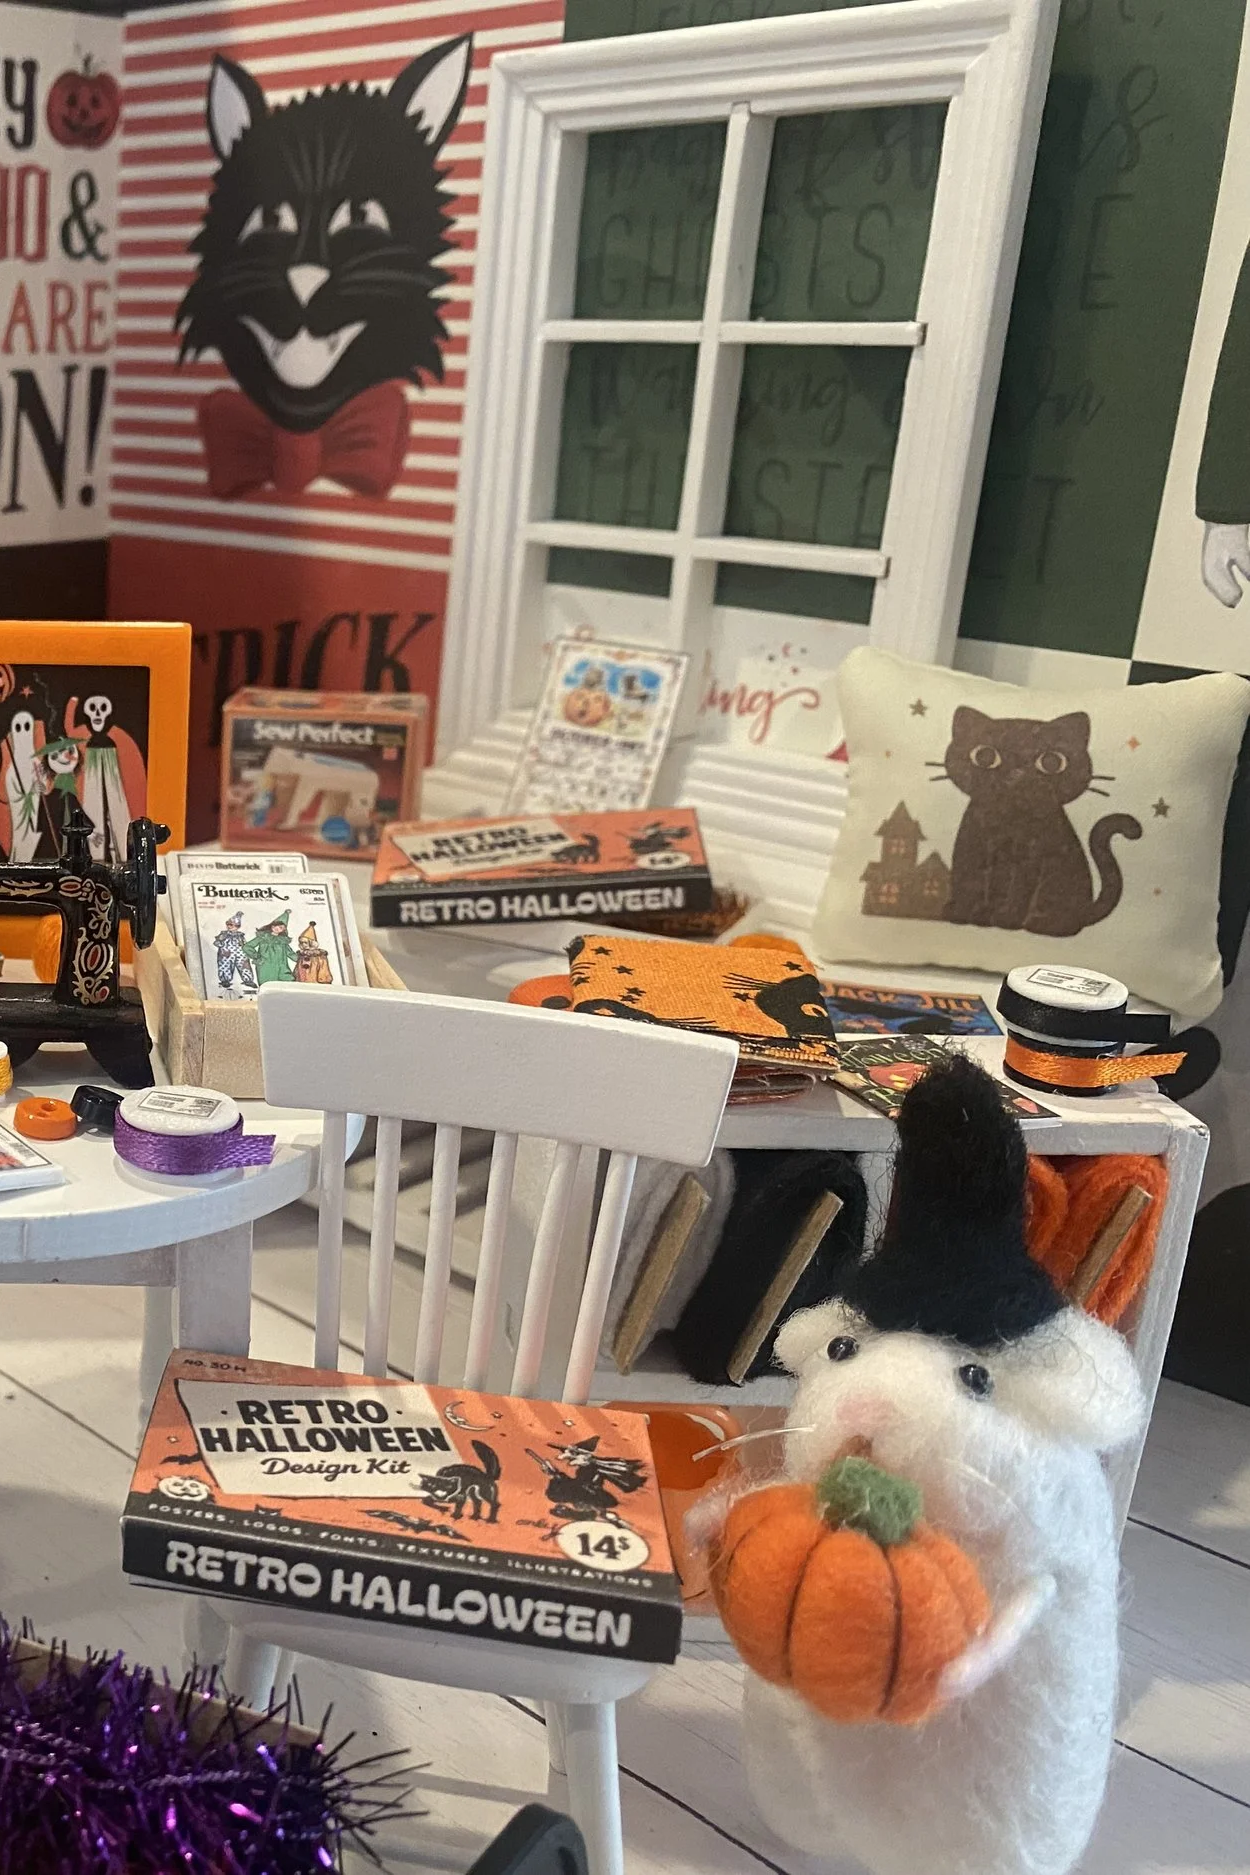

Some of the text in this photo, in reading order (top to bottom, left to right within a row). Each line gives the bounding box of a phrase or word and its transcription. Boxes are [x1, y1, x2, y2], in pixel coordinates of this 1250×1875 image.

[59, 168, 110, 264] &
[253, 721, 376, 746] Sew Perfect
[197, 884, 290, 901] Butterick
[400, 887, 684, 924] RETRO HALLOWEEN
[237, 1399, 390, 1425] RETRO
[200, 1427, 451, 1453] HALLOWEEN
[260, 1457, 412, 1482] Design Kit
[165, 1540, 632, 1648] RETRO HALLOWEEN
